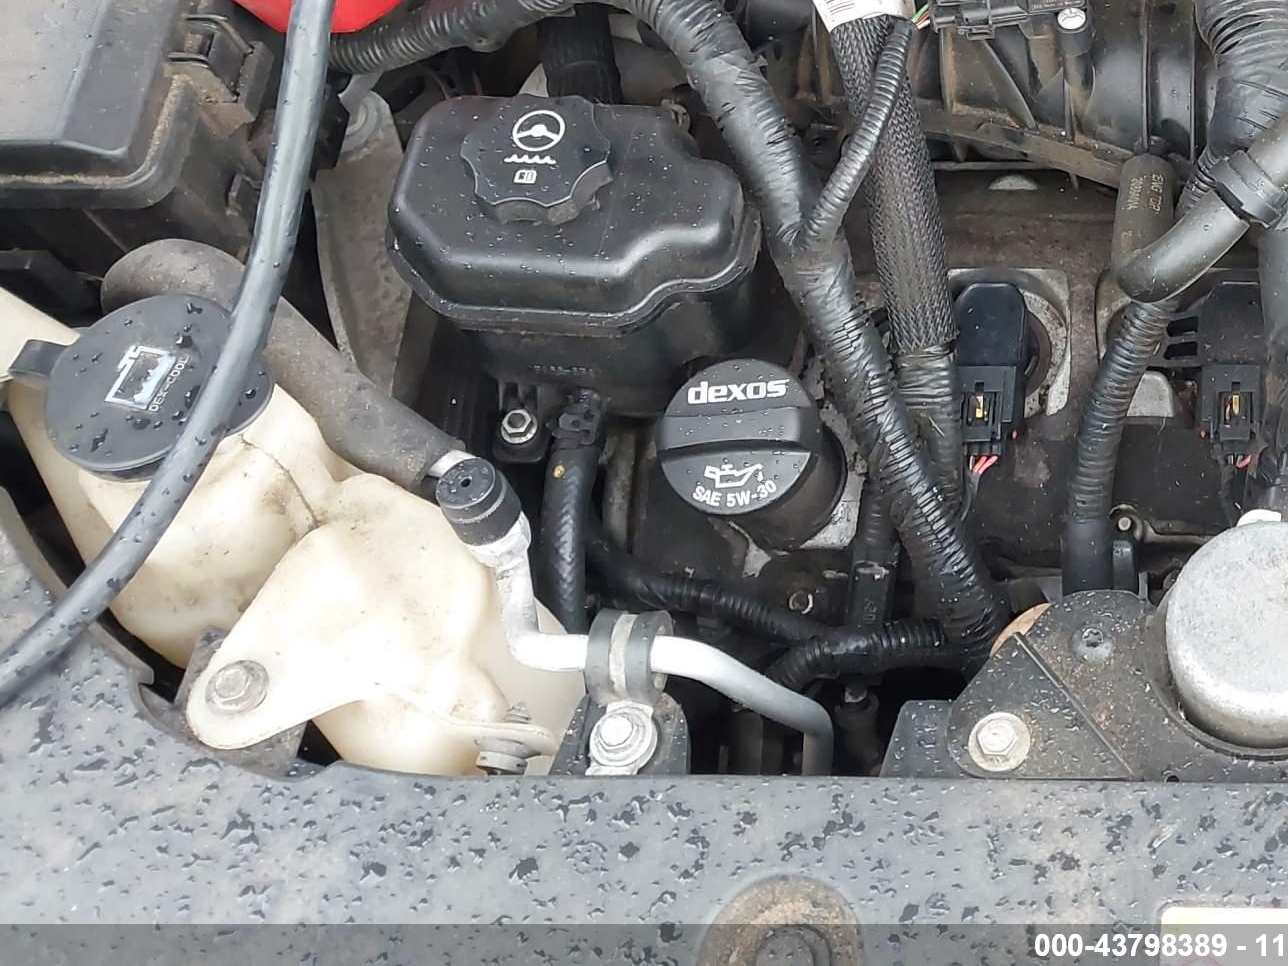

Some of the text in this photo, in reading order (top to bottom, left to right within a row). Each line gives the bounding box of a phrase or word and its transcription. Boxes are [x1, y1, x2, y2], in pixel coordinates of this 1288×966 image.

[148, 353, 190, 412] DEX-COOL
[687, 379, 790, 405] dexos
[692, 479, 777, 508] SAE 5W-30
